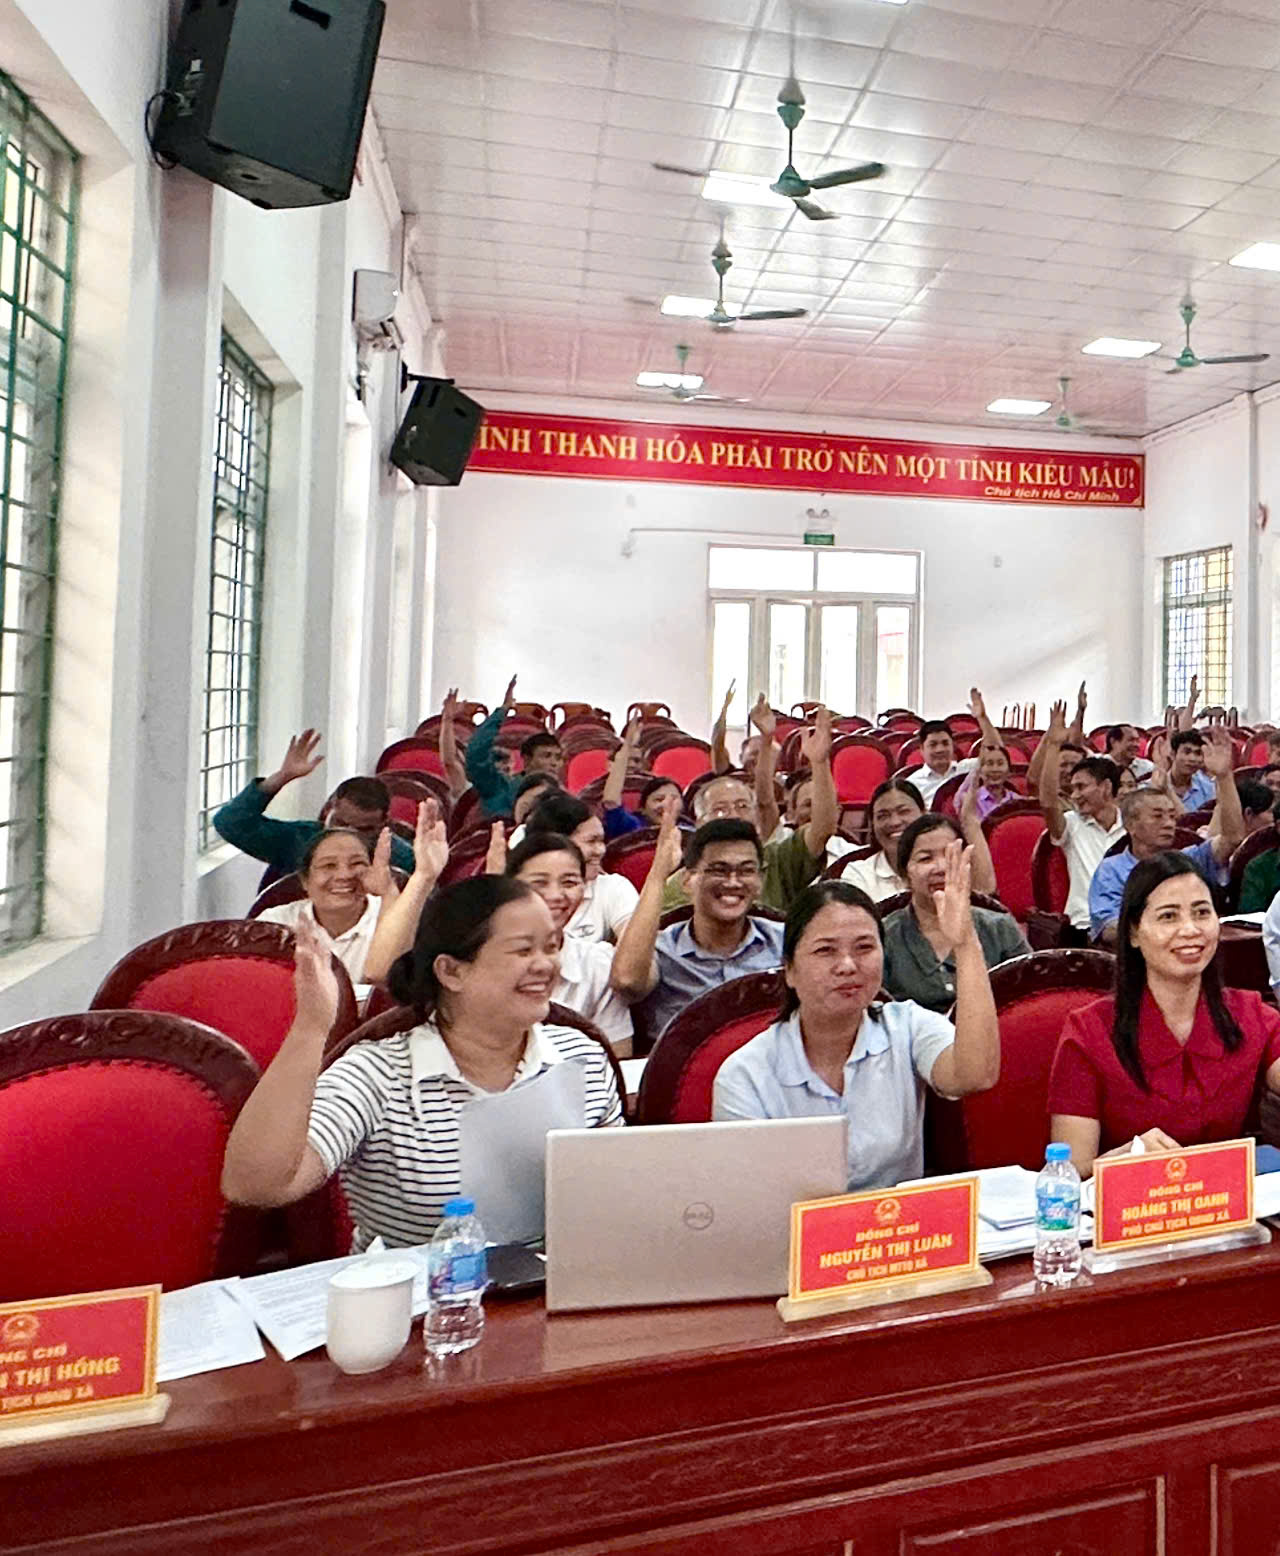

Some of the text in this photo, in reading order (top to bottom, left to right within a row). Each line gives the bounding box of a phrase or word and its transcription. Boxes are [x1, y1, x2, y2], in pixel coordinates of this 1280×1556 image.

[479, 418, 531, 453] ỈNH
[539, 430, 638, 461] THANH
[646, 433, 705, 465] HÓA
[711, 439, 774, 469] PHẢI
[779, 443, 834, 472] TRỞ
[838, 445, 889, 475] NÊN
[895, 453, 950, 484] MỘT
[956, 454, 1012, 482] TỈNH
[1088, 490, 1120, 502] Minh
[1121, 1202, 1168, 1221] HOÀNG
[1170, 1197, 1192, 1213] THỊ
[1194, 1192, 1230, 1209] OANH
[886, 1241, 911, 1257] THỊ
[14, 1365, 52, 1386] THỊ
